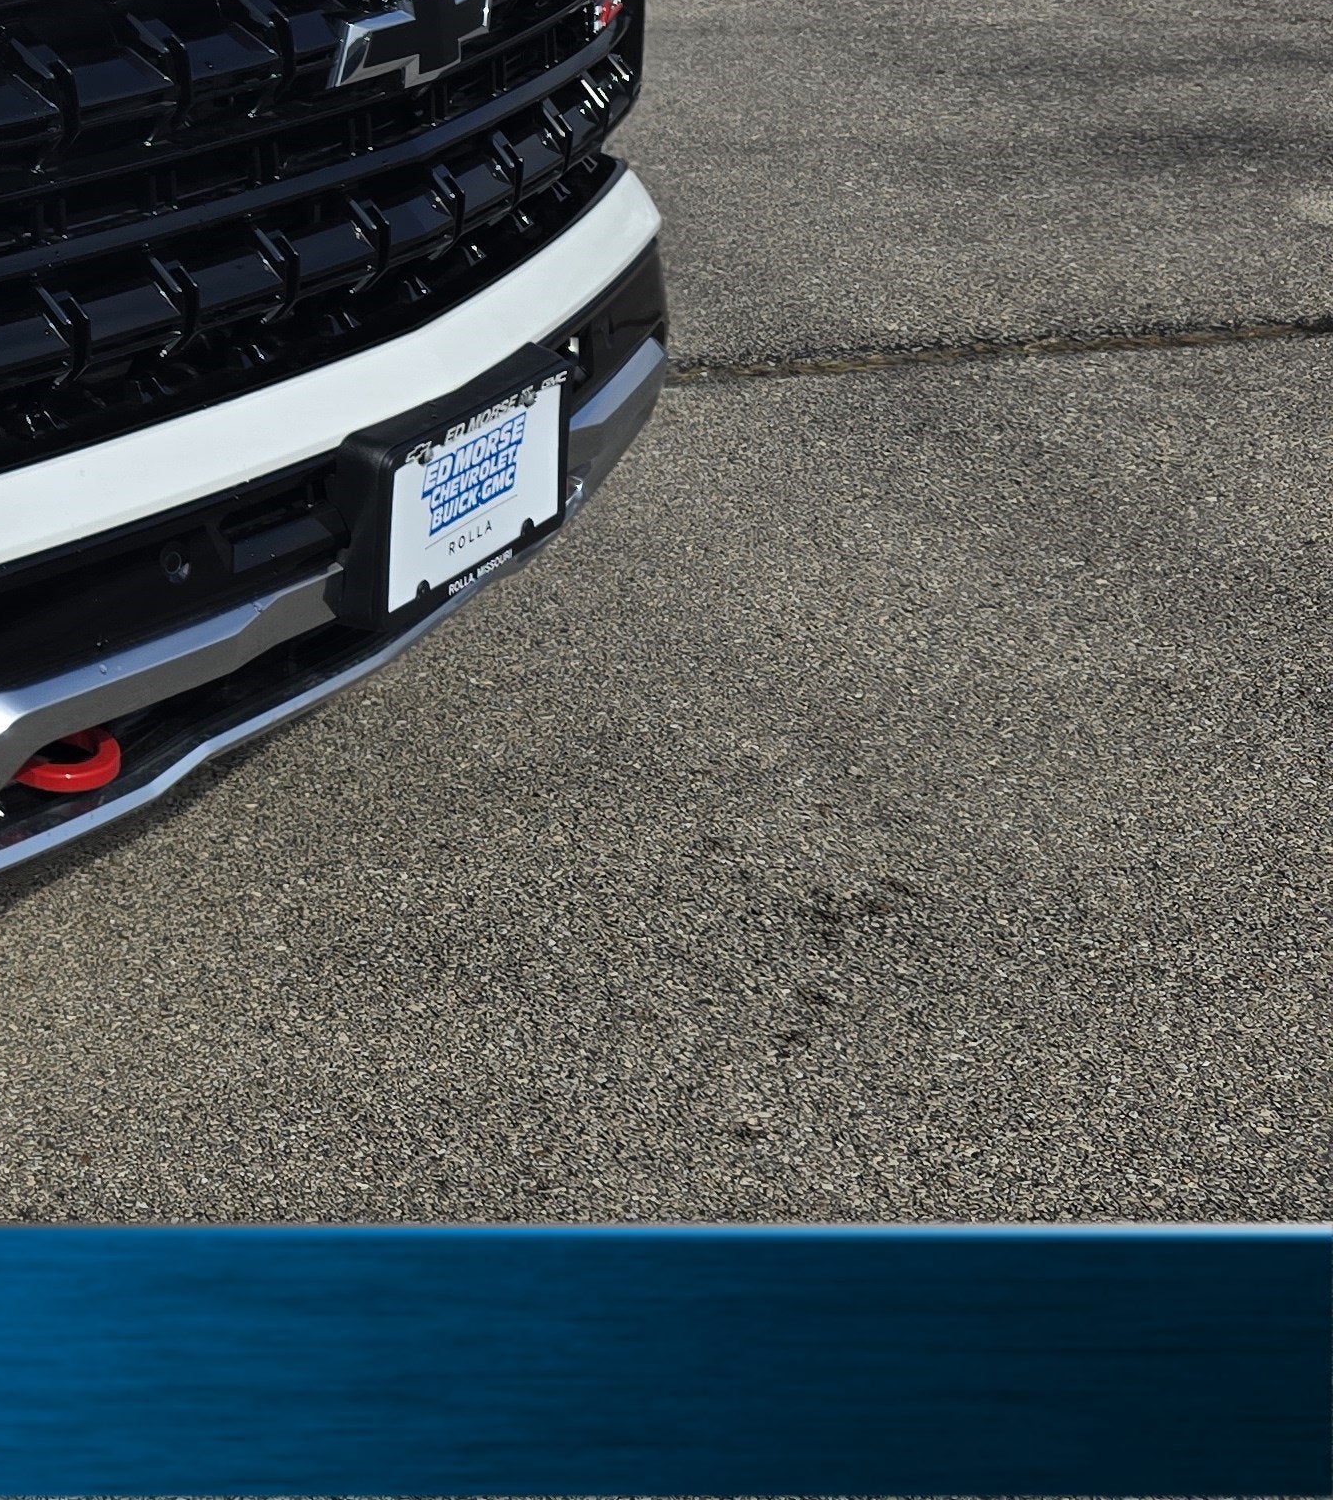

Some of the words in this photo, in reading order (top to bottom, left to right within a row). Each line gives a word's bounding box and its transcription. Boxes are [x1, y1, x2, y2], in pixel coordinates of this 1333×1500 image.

[445, 422, 466, 445] ED
[467, 393, 519, 434] MORSE
[422, 453, 455, 497] ED
[453, 412, 527, 478] MORSE
[430, 444, 518, 508] CHEVROLET
[448, 520, 492, 556] ROLLA
